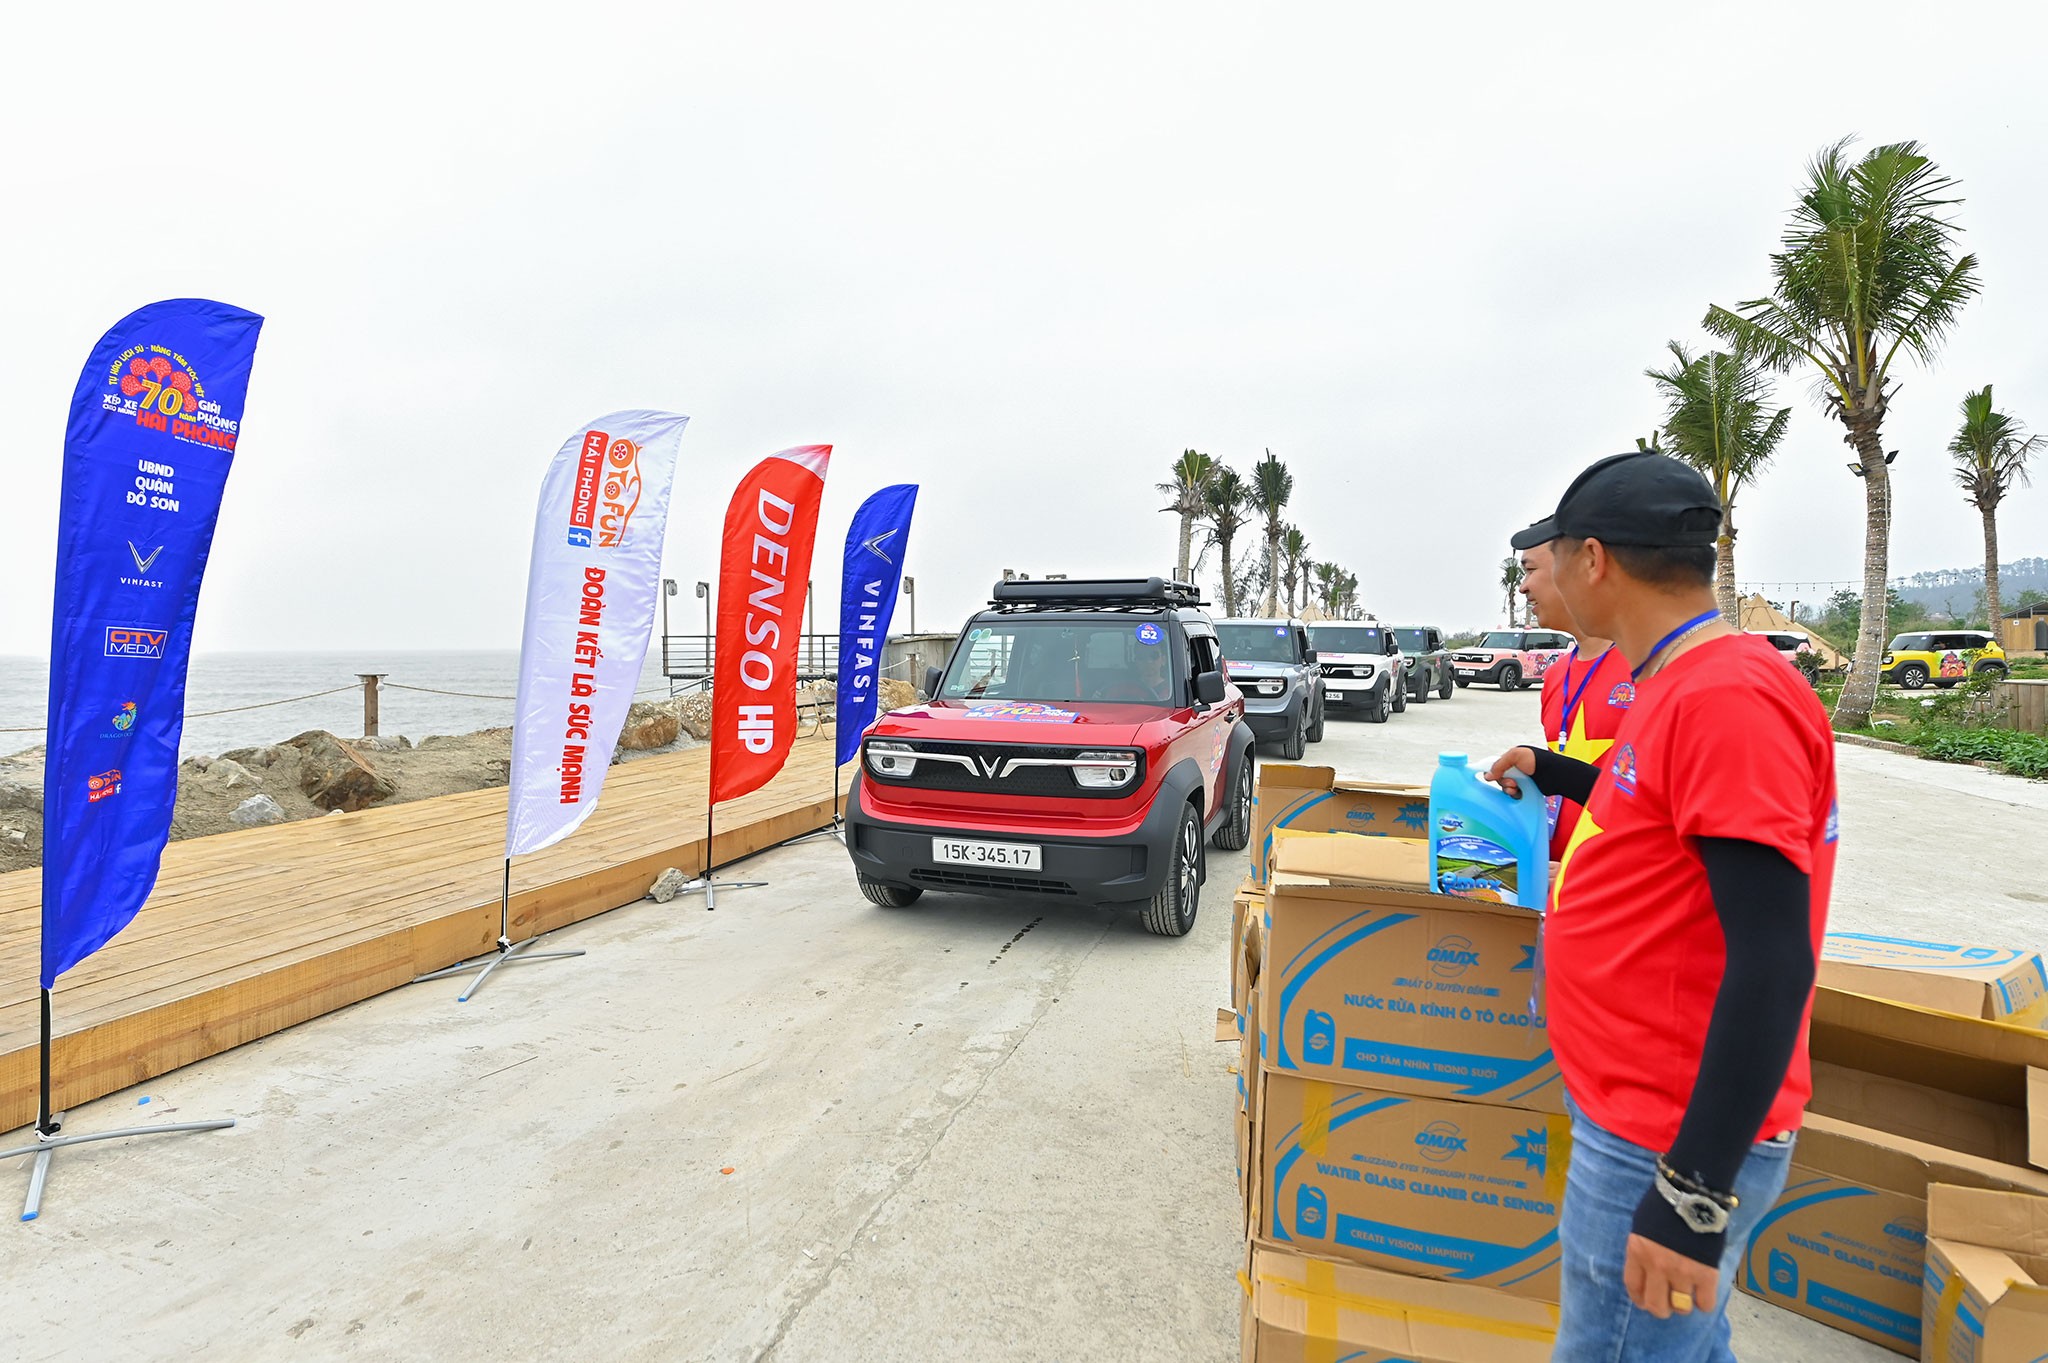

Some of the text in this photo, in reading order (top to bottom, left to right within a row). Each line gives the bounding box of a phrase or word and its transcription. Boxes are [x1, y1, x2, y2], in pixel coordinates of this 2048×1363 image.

[124, 399, 138, 410] XE
[140, 379, 183, 416] 70
[198, 400, 221, 415] GIẢI
[136, 408, 167, 432] HẢI
[172, 419, 237, 451] PHÒNG
[197, 411, 238, 431] PHÓNG
[138, 459, 174, 477] UBND
[135, 476, 173, 494] QUẬN
[575, 436, 601, 523] HẢI PHÒNG
[126, 490, 180, 512] ĐỒ SƠN
[120, 577, 163, 588] VINFAST
[737, 487, 795, 755] DENSO HP
[110, 630, 164, 645] OTV
[110, 643, 160, 658] MEDIA
[556, 567, 606, 804] ĐOÀN KẾT LÀ SỨC MẠNH
[944, 844, 1031, 864] 15K-345.17
[1460, 1006, 1472, 1020] Ô
[1476, 1008, 1494, 1023] TÔ
[1499, 1013, 1530, 1027] CAO
[1356, 1052, 1377, 1063] CHO
[1433, 1063, 1468, 1076] TRONG
[1527, 1144, 1547, 1154] NE
[1316, 1162, 1555, 1216] WATER GLASS CLEANER CAR SENIOR
[1351, 1229, 1475, 1262] CREATE VISION LIMPIDITY
[1787, 1232, 1830, 1256] WATER
[1834, 1249, 1875, 1271] GLASS
[1878, 1264, 1923, 1288] CLEAN
